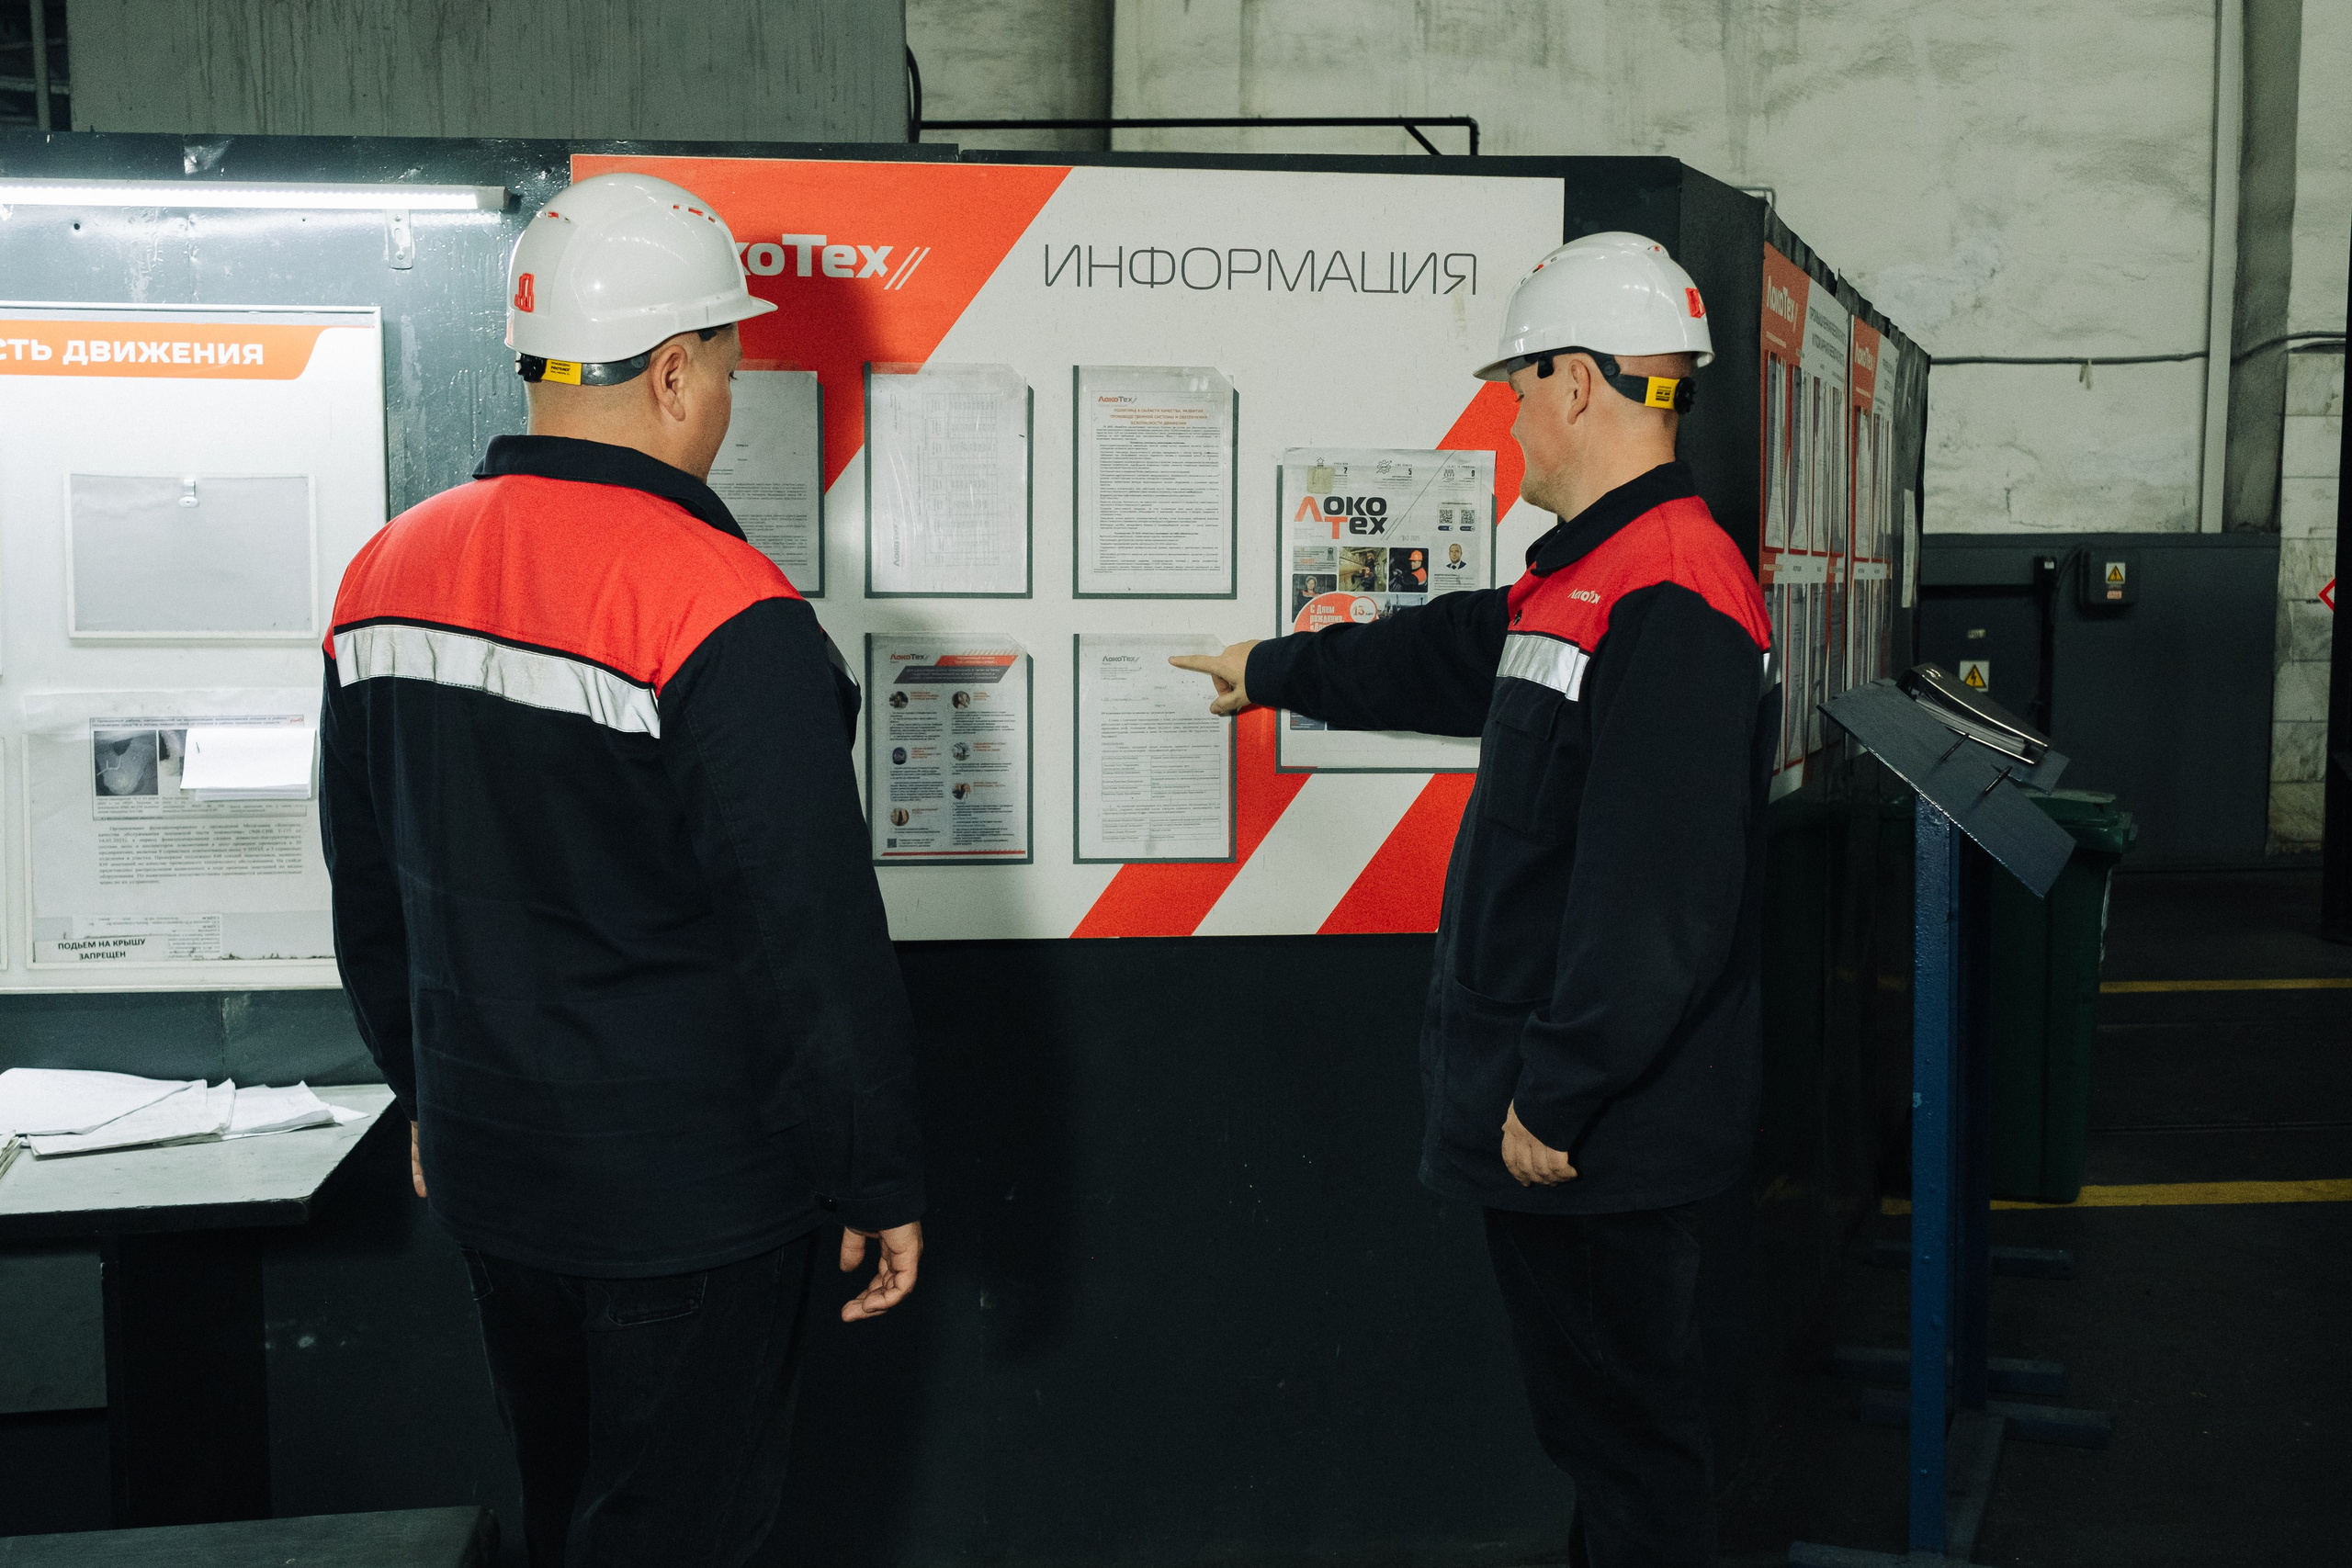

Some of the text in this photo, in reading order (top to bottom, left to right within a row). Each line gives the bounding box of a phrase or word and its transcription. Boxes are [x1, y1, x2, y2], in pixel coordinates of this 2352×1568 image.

[1045, 244, 1477, 295] ИНФОРМАЦИЯ
[62, 340, 264, 366] ДВИЖЕНИЯ
[98, 940, 111, 948] НА
[113, 938, 146, 947] КРЫШУ
[79, 951, 127, 960] ЗАПРЕЩЕН
